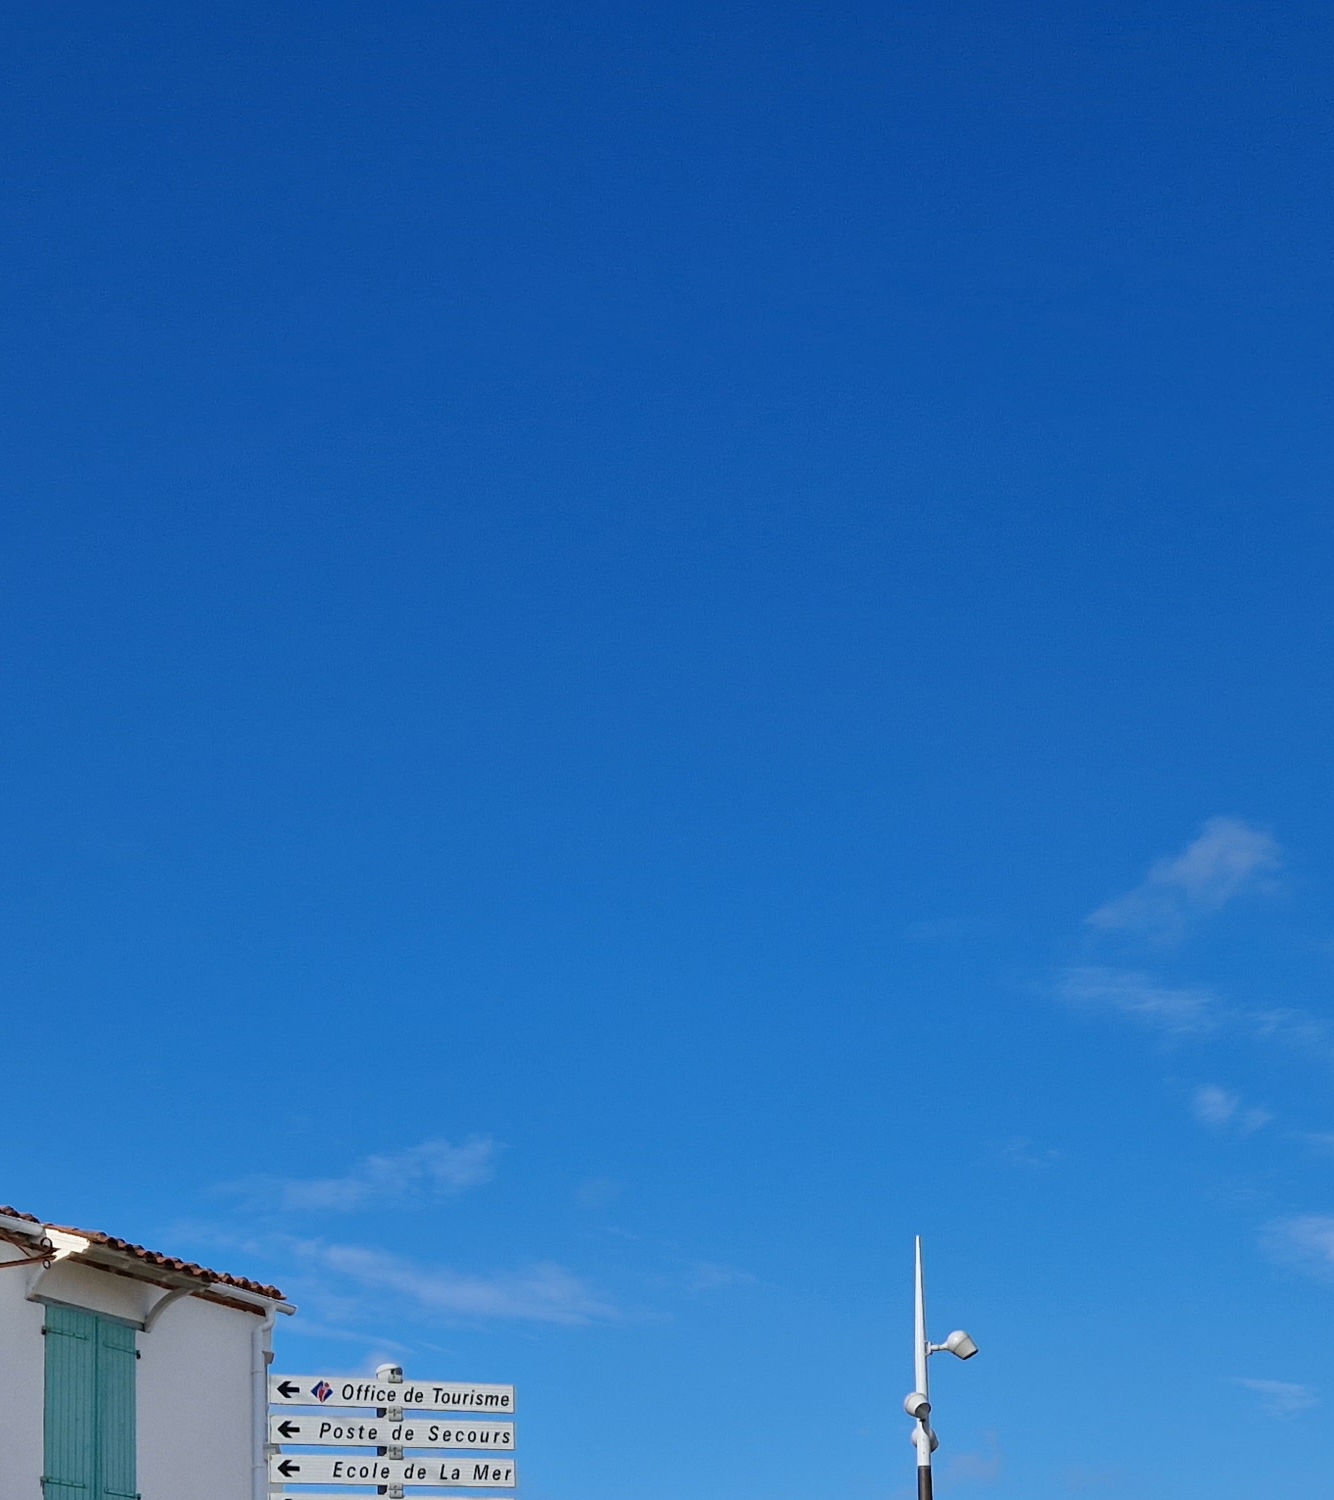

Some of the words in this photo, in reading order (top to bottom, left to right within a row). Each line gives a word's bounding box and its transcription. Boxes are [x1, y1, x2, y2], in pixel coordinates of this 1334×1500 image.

[342, 1384, 396, 1402] Office
[404, 1387, 424, 1402] de
[433, 1388, 510, 1407] Tourisme
[319, 1422, 378, 1440] Poste
[392, 1425, 414, 1441] de
[428, 1426, 510, 1444] Secours
[333, 1461, 390, 1479] Ecole
[404, 1464, 426, 1480] de
[439, 1464, 460, 1480] La
[473, 1464, 512, 1481] Mer
